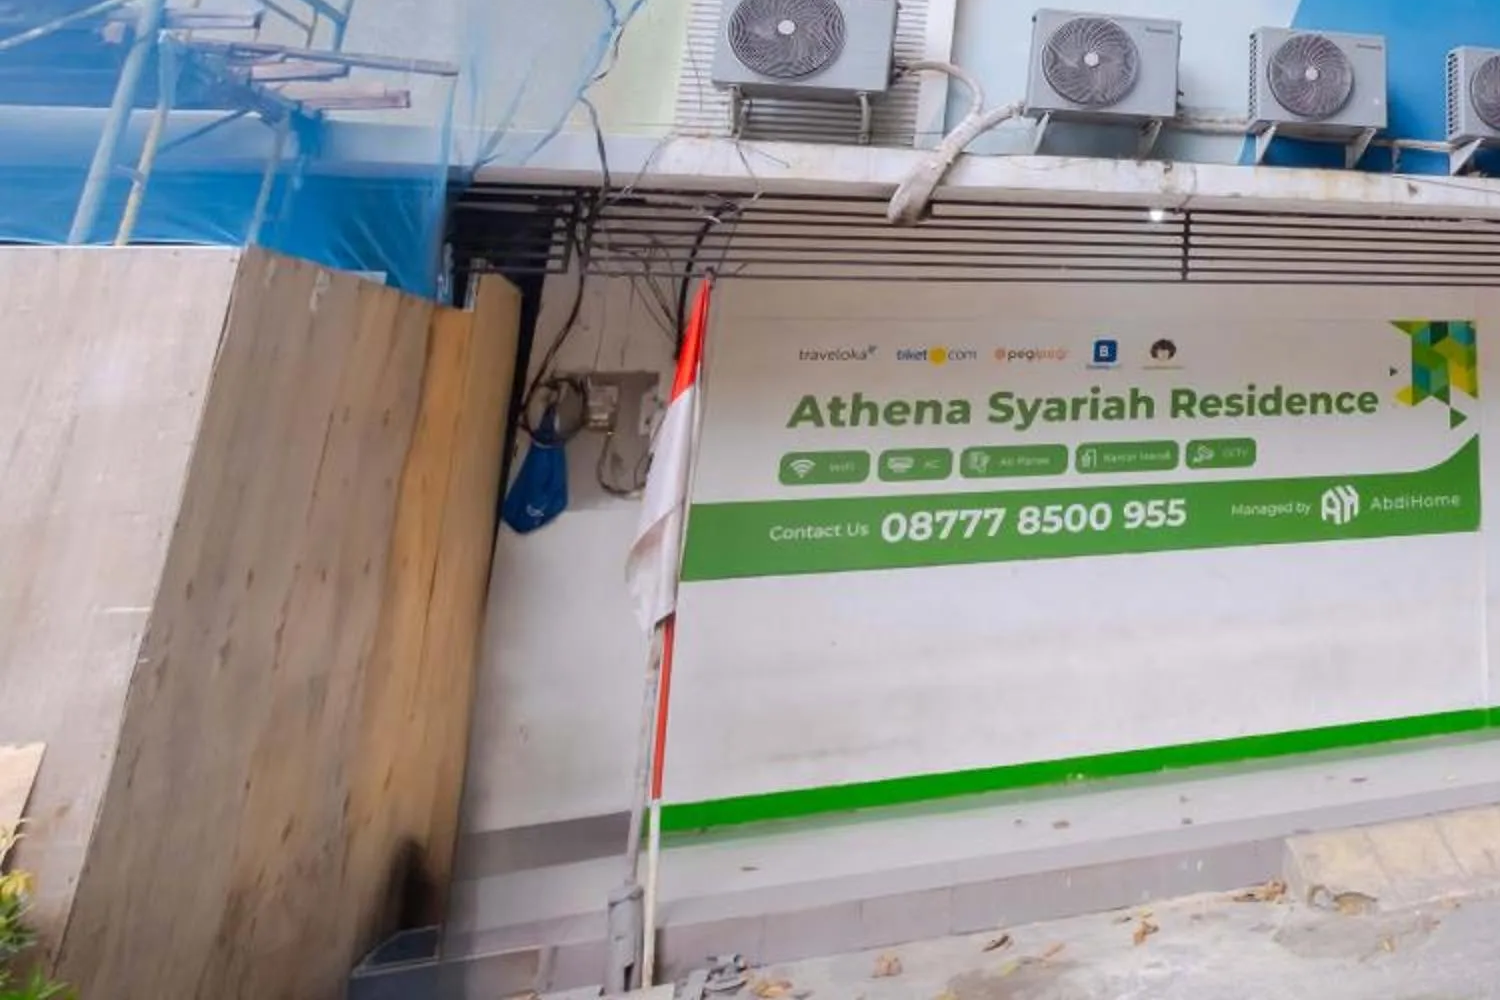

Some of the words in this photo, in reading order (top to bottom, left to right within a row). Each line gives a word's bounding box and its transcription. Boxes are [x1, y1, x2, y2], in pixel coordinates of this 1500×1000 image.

[786, 392, 972, 428] Athena
[987, 386, 1155, 431] Syariah
[1170, 385, 1379, 418] Residence
[769, 523, 843, 541] Contact
[847, 521, 870, 537] Us
[881, 507, 1006, 543] 08777
[1017, 502, 1113, 536] 8500
[1123, 498, 1188, 529] 955
[1231, 501, 1293, 518] Managed
[1296, 502, 1312, 516] by
[1369, 493, 1462, 512] AbdiHome
